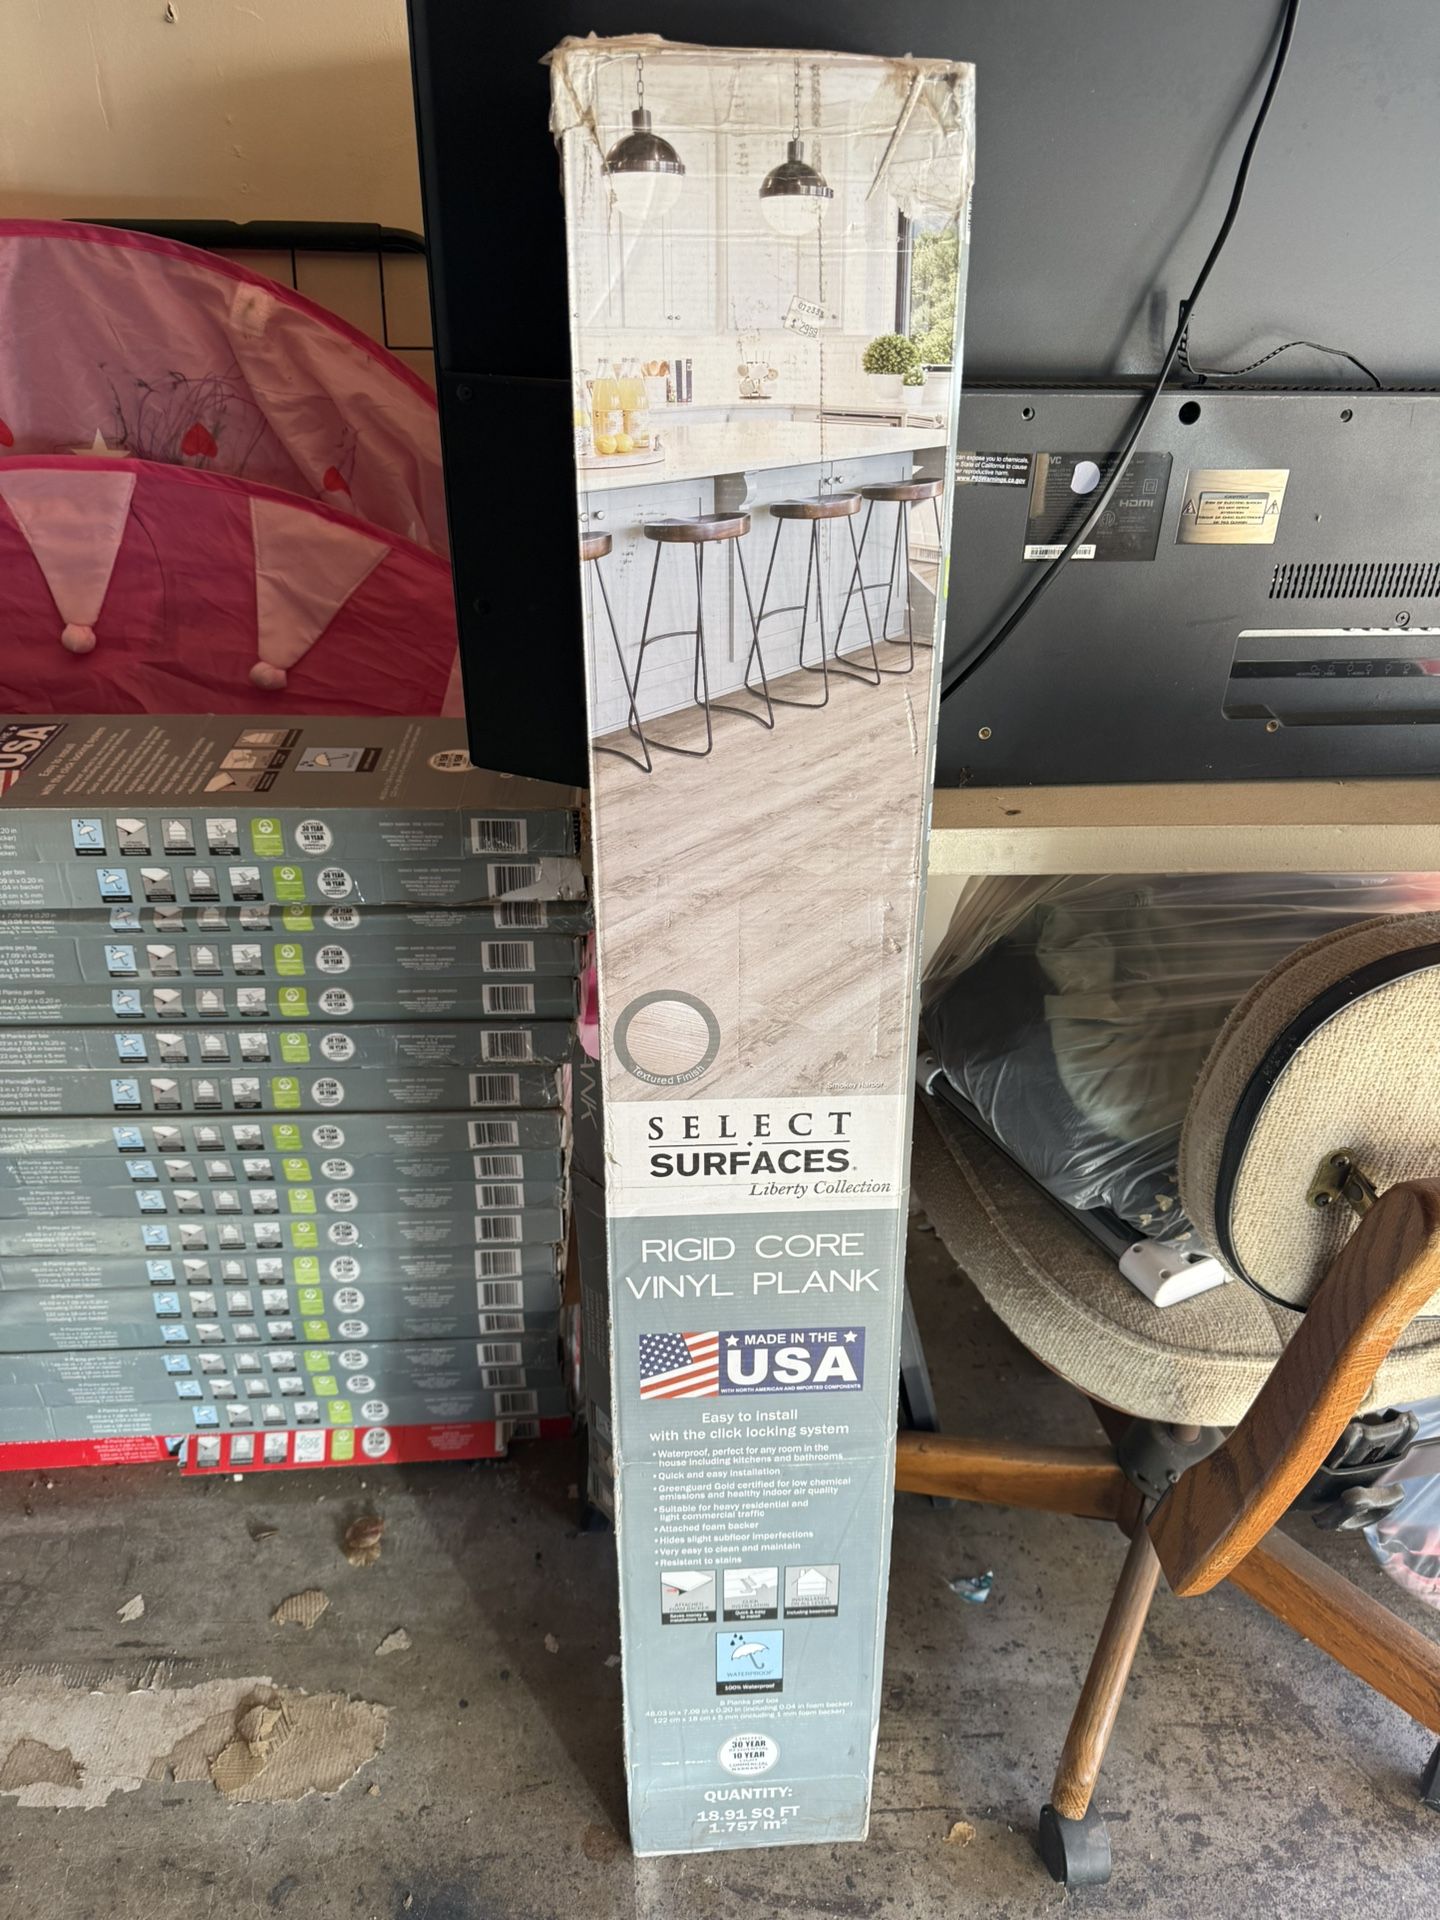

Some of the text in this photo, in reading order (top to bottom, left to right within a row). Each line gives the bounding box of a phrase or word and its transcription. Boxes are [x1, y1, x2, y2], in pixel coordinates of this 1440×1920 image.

[1047, 456, 1062, 464] VC
[1120, 499, 1154, 508] HDMI
[0, 724, 57, 769] USA
[632, 1065, 704, 1084] Textured Finish
[580, 1056, 598, 1130] ANK
[648, 1112, 851, 1140] SELECT
[650, 1148, 850, 1178] SURFACES
[749, 1179, 891, 1198] Liberty Collection
[642, 1233, 864, 1263] RIGID CORE
[625, 1269, 880, 1300] VINYL PLANK
[744, 1332, 838, 1345] MADE IN THE
[727, 1346, 858, 1386] USA
[702, 1412, 734, 1424] Easy
[738, 1412, 752, 1422] to
[650, 1424, 849, 1441] with the click locking system
[658, 1448, 710, 1459] Waterproof,
[712, 1447, 744, 1457] perfect
[746, 1446, 758, 1454] for
[760, 1447, 776, 1455] any
[804, 1444, 812, 1452] in
[814, 1444, 829, 1452] the
[690, 1457, 731, 1466] including
[733, 1455, 771, 1464] kitchens
[774, 1454, 792, 1462] and
[794, 1453, 843, 1462] bathrooms
[658, 1468, 780, 1480] Quick and easy installation
[658, 1483, 712, 1493] Greenguard
[714, 1482, 735, 1490] Gold
[738, 1480, 774, 1489] certified
[777, 1480, 789, 1488] for
[810, 1476, 851, 1486] chemical
[660, 1492, 705, 1500] emissions
[728, 1489, 760, 1498] healthy
[763, 1487, 791, 1496] indoor
[794, 1487, 806, 1495] air
[808, 1486, 838, 1496] quality
[659, 1500, 808, 1513] Suitable for heavy residential and
[660, 1510, 764, 1522] light commercial traffic
[660, 1522, 759, 1533] Attached foam backer
[660, 1530, 814, 1544] Hides slight subfloor imperfections
[660, 1548, 679, 1556] Very
[682, 1548, 702, 1556] easy
[704, 1546, 714, 1554] to
[742, 1544, 759, 1552] and
[761, 1542, 800, 1551] maintain
[660, 1558, 702, 1566] Resistant
[715, 1556, 742, 1564] stains
[726, 1670, 772, 1678] WATERPROOF
[732, 1740, 766, 1748] 30 YEAR
[704, 1786, 792, 1803] QUANTITY:
[697, 1805, 800, 1822] 18.91 SQ FT
[708, 1821, 758, 1834] 1.757
